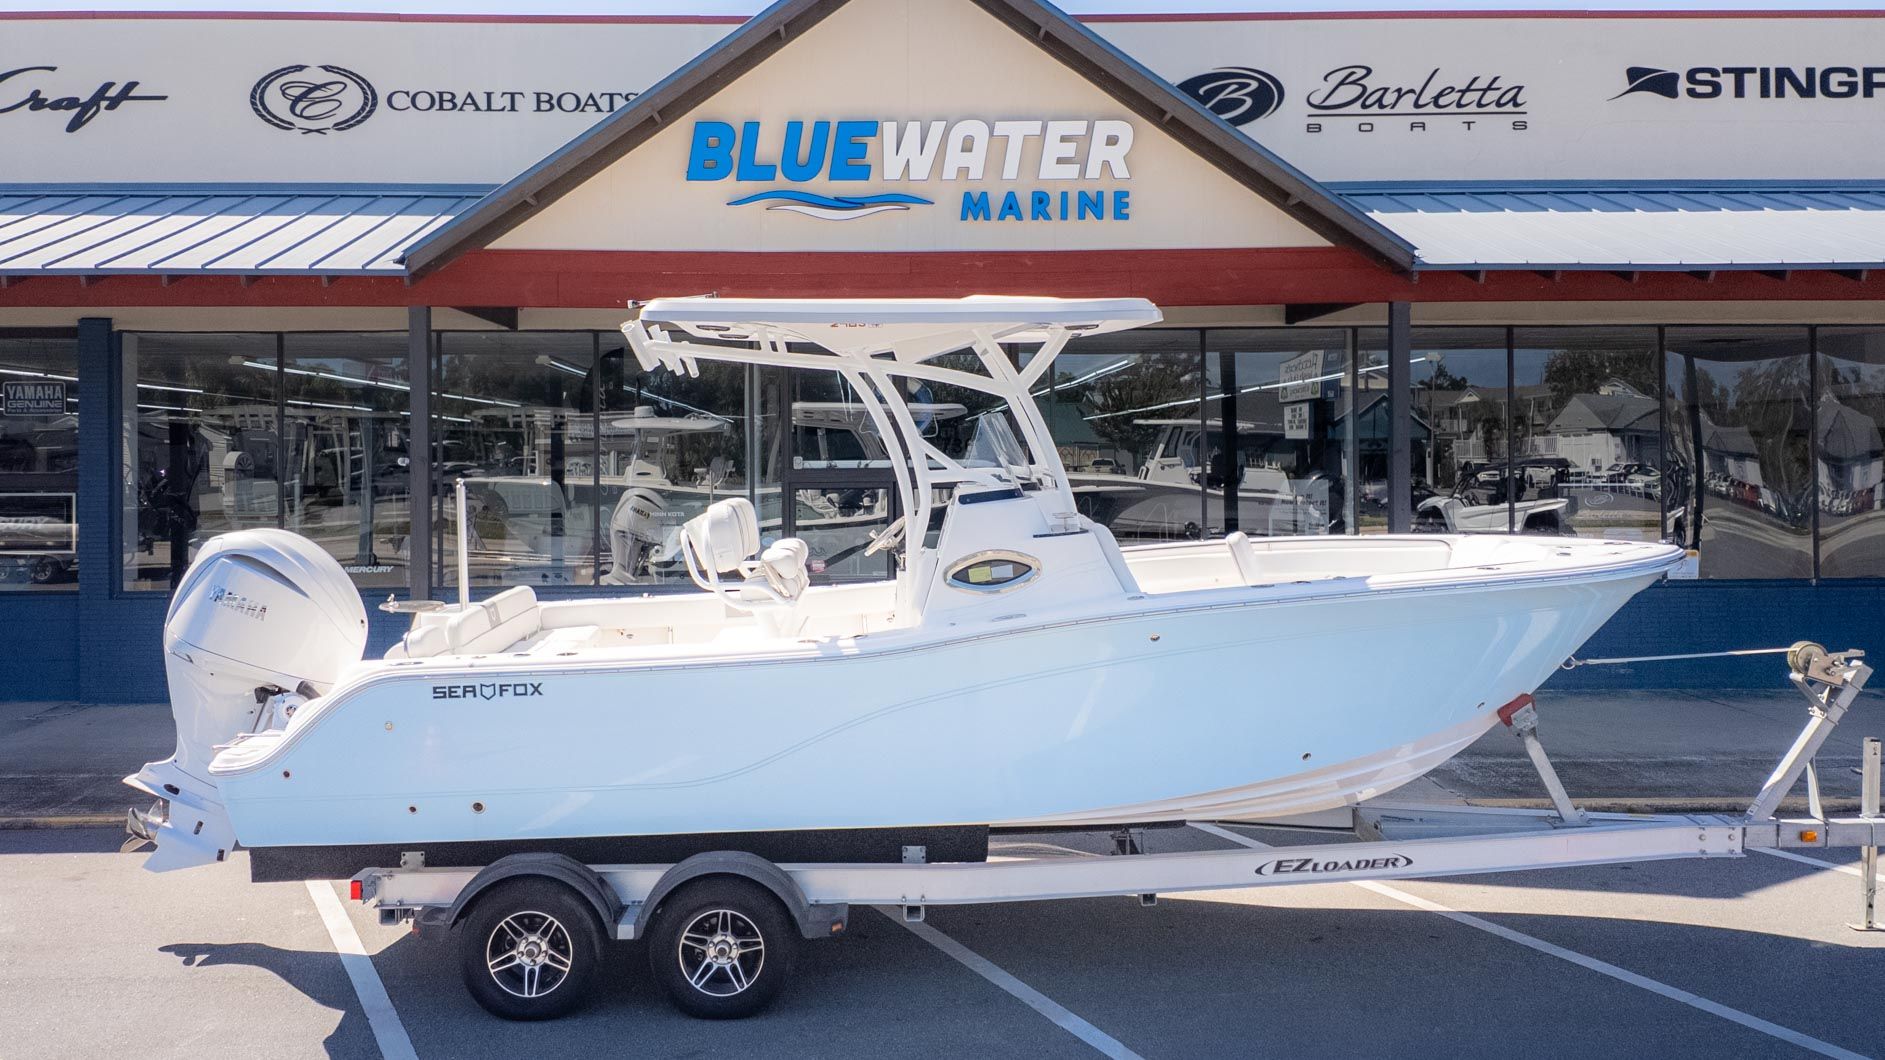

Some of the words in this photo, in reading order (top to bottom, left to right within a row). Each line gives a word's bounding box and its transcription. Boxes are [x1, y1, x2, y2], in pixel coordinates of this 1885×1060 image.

[1306, 65, 1528, 110] Barletta
[387, 90, 525, 112] COBALT
[1306, 121, 1528, 133] BOATS
[686, 119, 1135, 182] BLUEWATER
[959, 190, 1131, 221] MARINE
[6, 385, 63, 400] YAMAHA
[7, 400, 63, 408] GENUINE
[344, 565, 394, 574] MERCURY
[208, 585, 268, 621] YAMAHA
[432, 684, 478, 699] SEA
[499, 682, 544, 697] FOX
